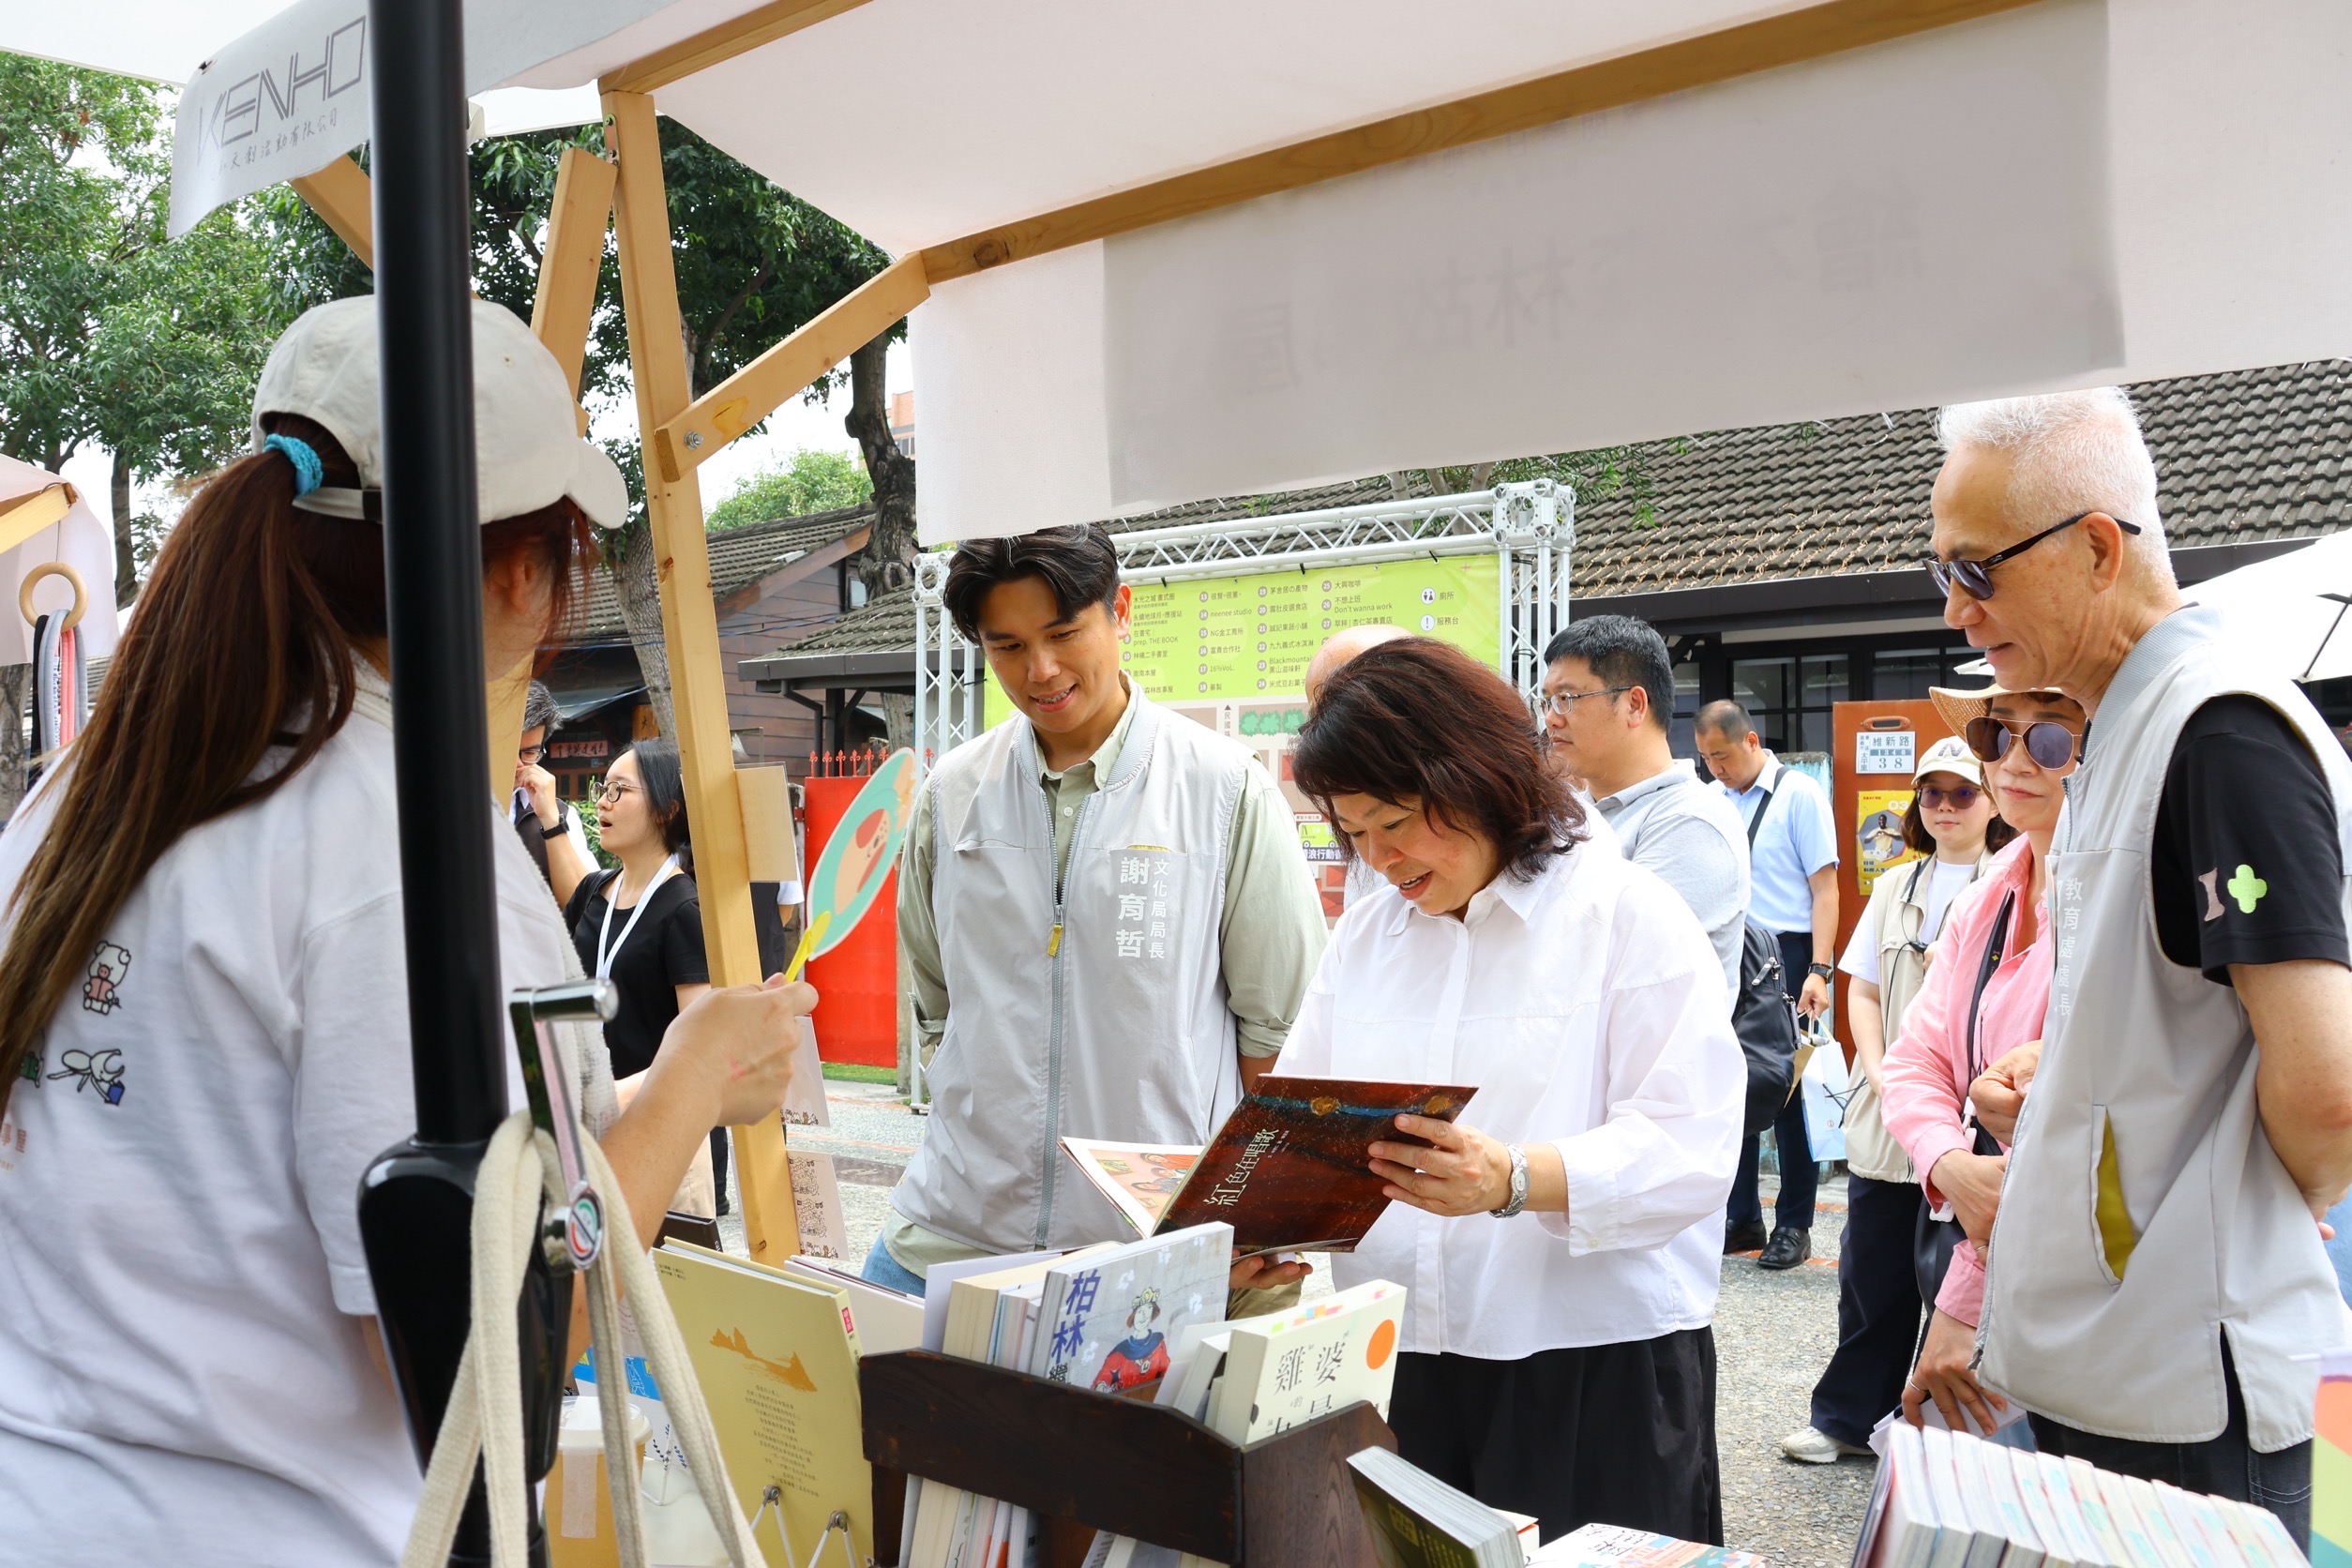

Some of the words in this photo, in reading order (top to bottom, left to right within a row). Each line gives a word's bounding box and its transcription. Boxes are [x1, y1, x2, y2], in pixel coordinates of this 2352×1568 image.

[1334, 596, 1361, 604] 不想上班
[1437, 616, 1459, 626] 服務台
[1269, 656, 1312, 664] Blackmountai
[1873, 735, 1909, 746] 維新路
[1878, 758, 1903, 769] 38
[1116, 857, 1150, 958] 謝育哲
[1149, 858, 1170, 959] 文化局局長
[1203, 1128, 1279, 1207] 紅色在唱歌
[1051, 1269, 1101, 1364] 柏林
[1274, 1340, 1346, 1395] 雞婆
